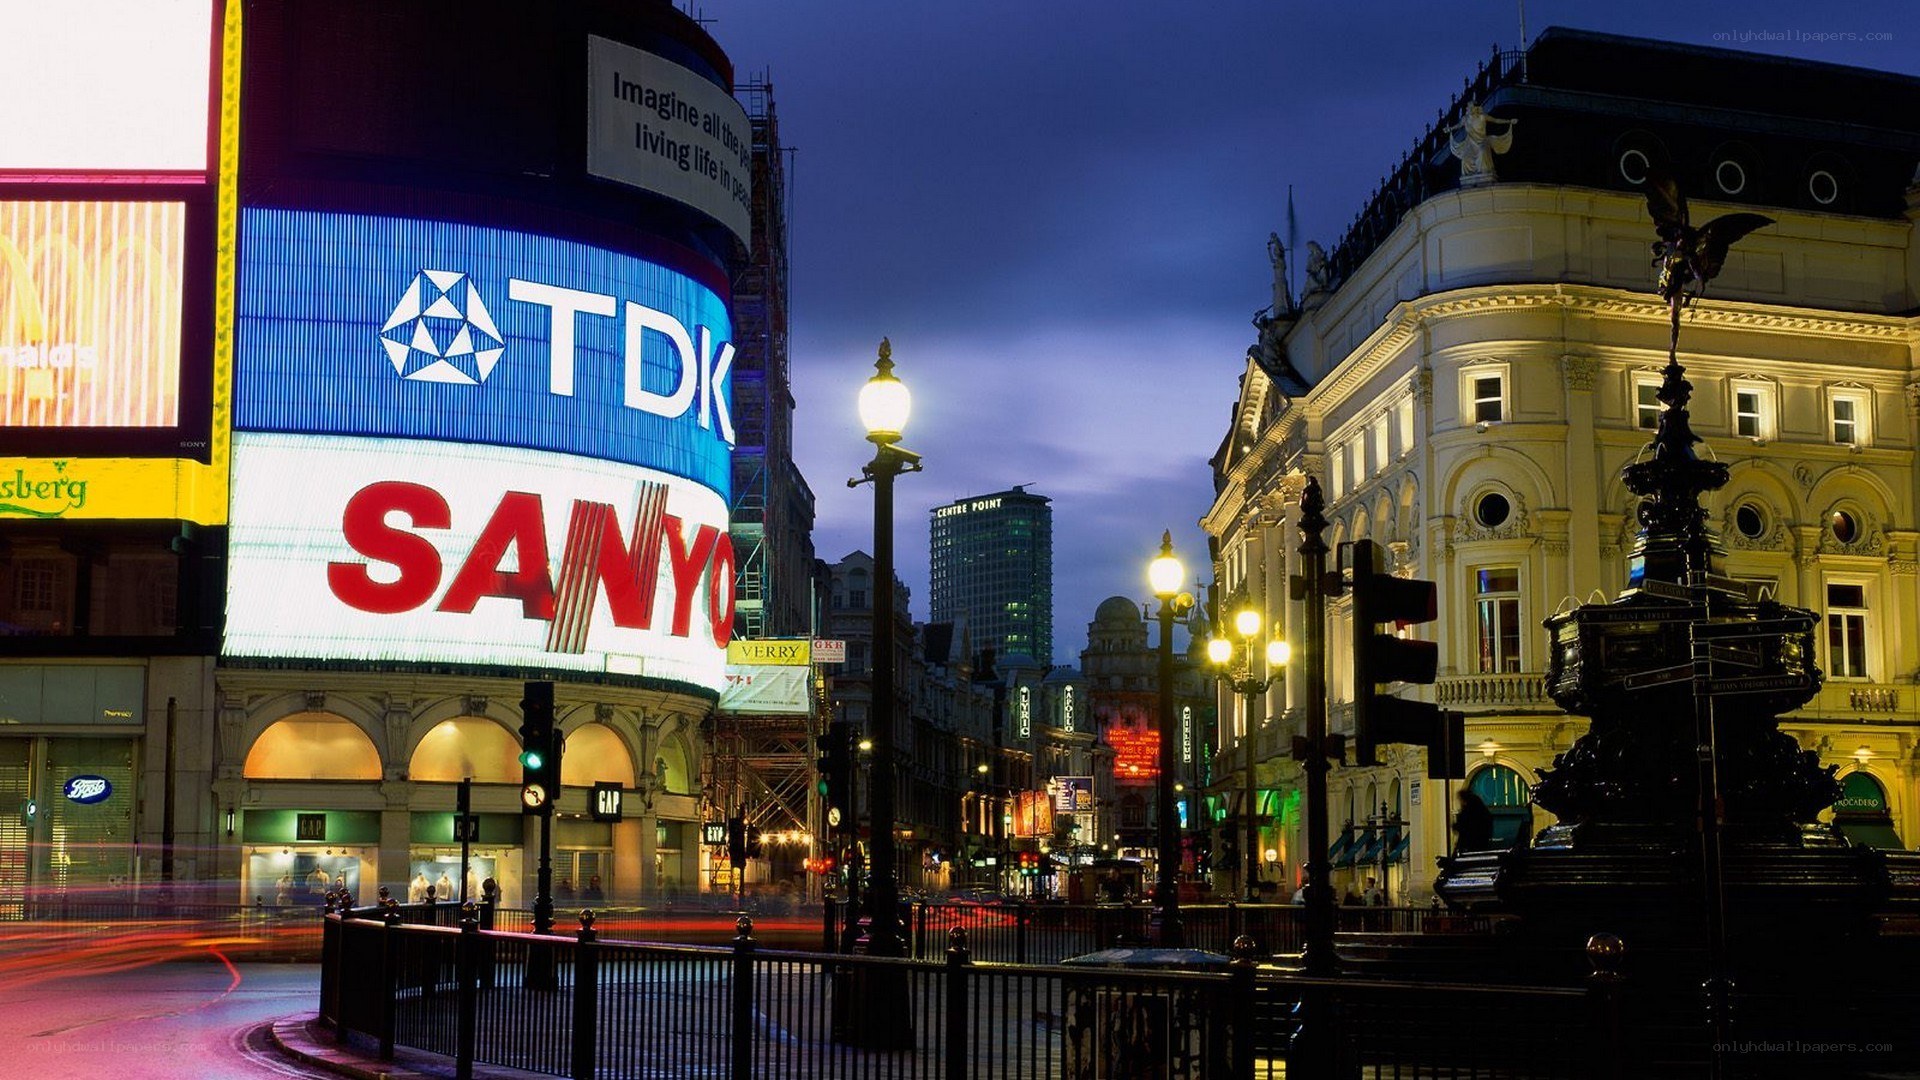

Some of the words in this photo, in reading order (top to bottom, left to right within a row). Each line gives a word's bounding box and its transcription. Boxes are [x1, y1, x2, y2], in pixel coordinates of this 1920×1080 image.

[614, 72, 699, 127] Imagine
[703, 111, 720, 140] all
[722, 122, 739, 156] the
[635, 122, 690, 172] living
[694, 146, 718, 181] life
[720, 160, 730, 191] in
[509, 278, 736, 449] TDK
[180, 441, 206, 449] SONY
[937, 503, 967, 518] CENTRE
[972, 498, 1002, 512] POINT
[328, 480, 736, 653] SANYO
[742, 646, 799, 658] VERRY
[1020, 694, 1029, 735] LYRIC
[1064, 690, 1074, 733] APOLLO
[67, 778, 106, 799] Boots
[599, 790, 620, 814] GAP
[1836, 798, 1879, 809] ROCADERO
[301, 819, 322, 836] GAP
[456, 819, 476, 837] GP
[707, 826, 723, 842] GAP
